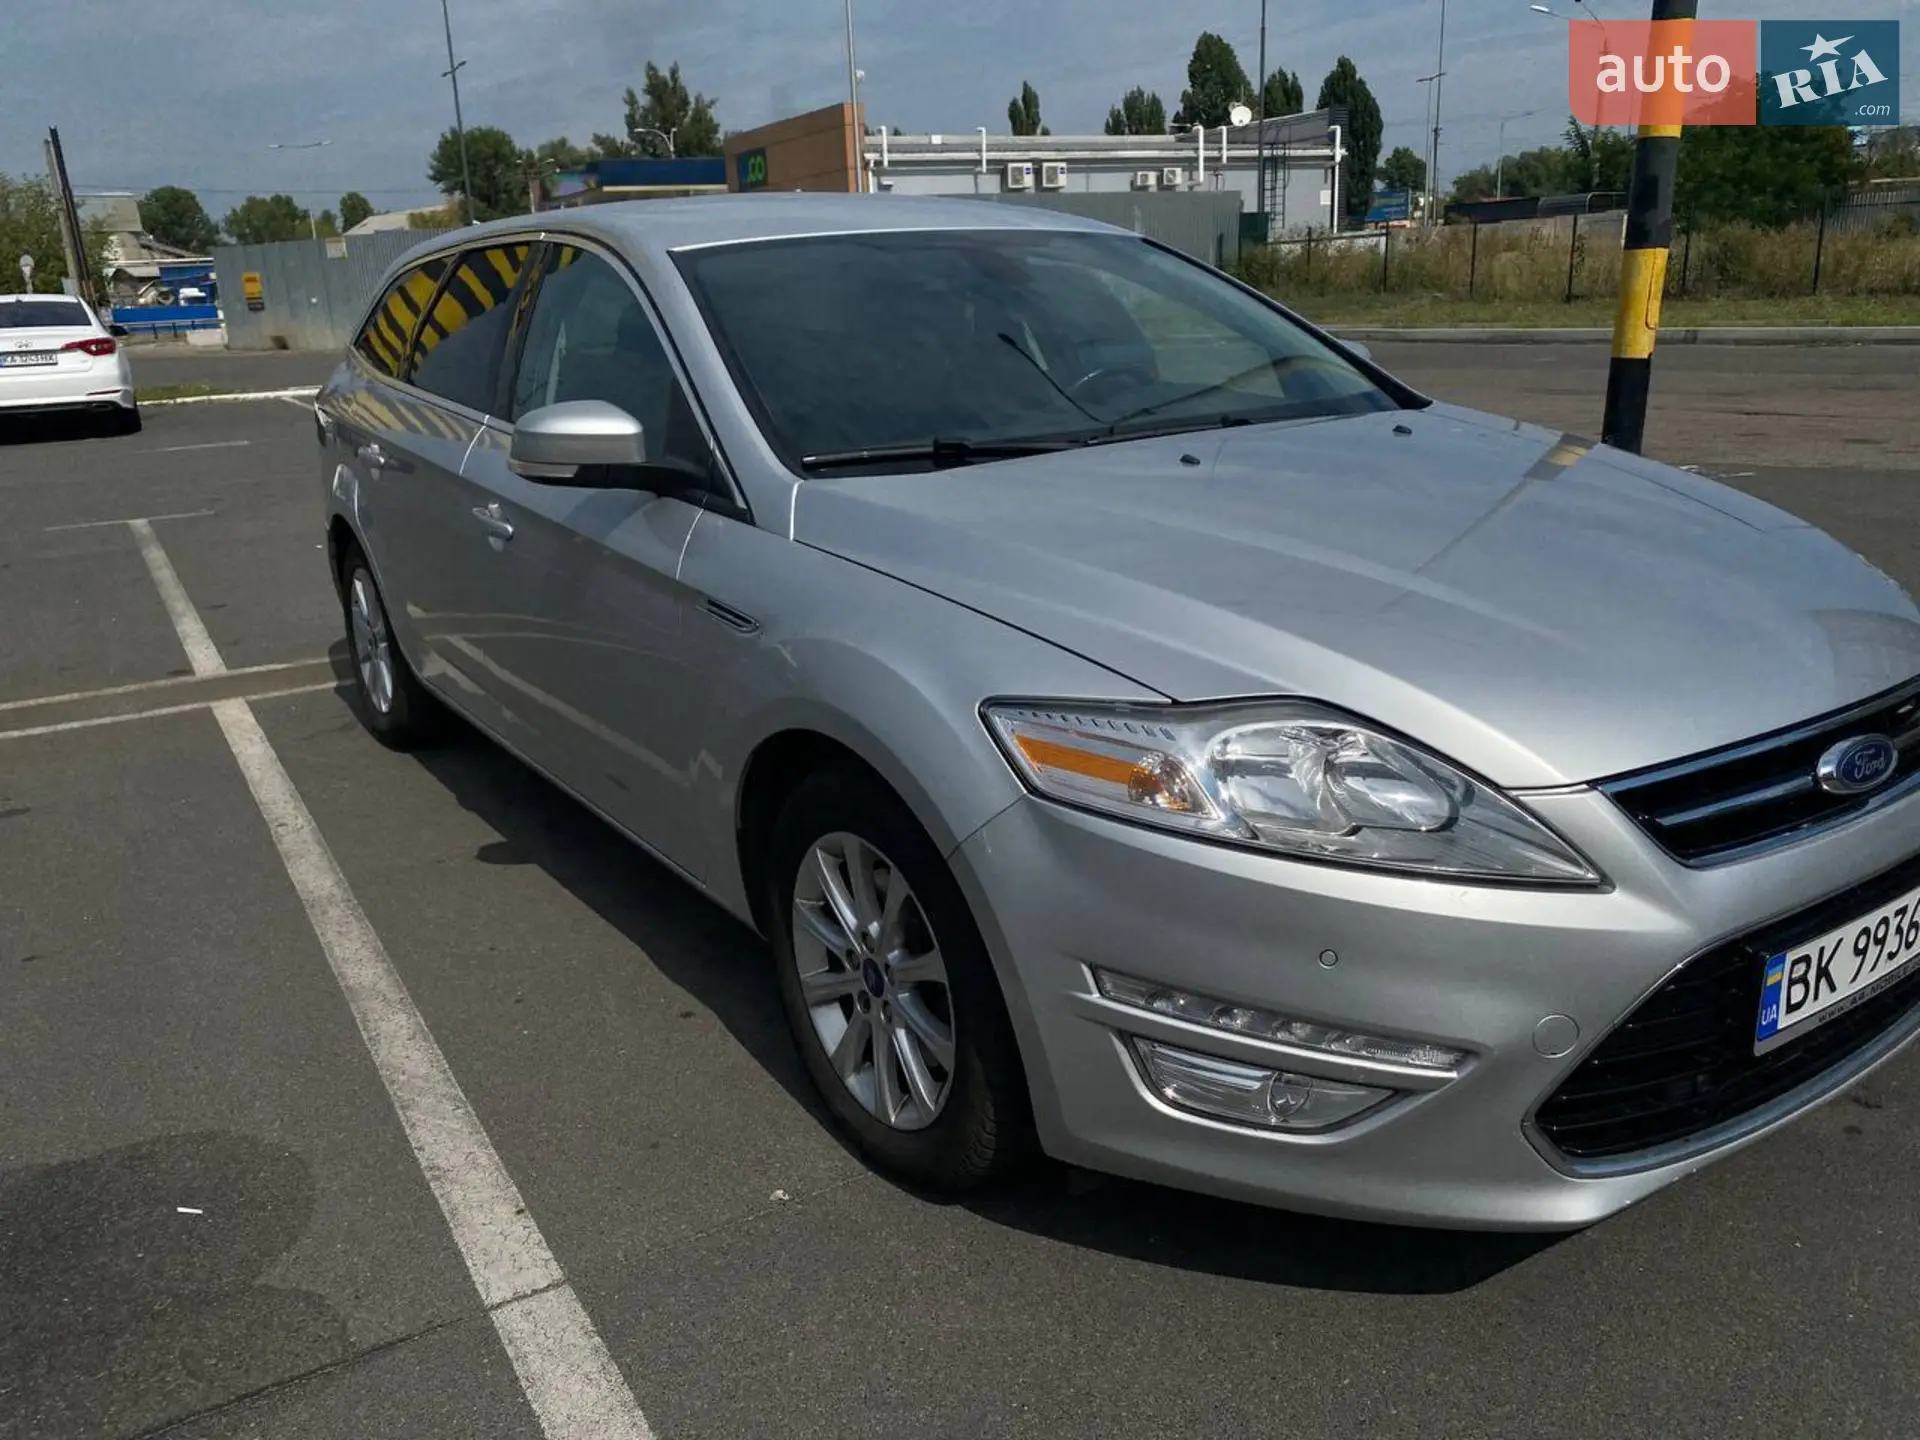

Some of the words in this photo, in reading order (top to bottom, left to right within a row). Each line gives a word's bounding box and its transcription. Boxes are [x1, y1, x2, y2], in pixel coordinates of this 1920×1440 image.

[1854, 748, 1886, 780] Ford
[1786, 937, 1844, 1015] BK
[1849, 897, 1920, 984] 9936
[1761, 1004, 1777, 1025] UA
